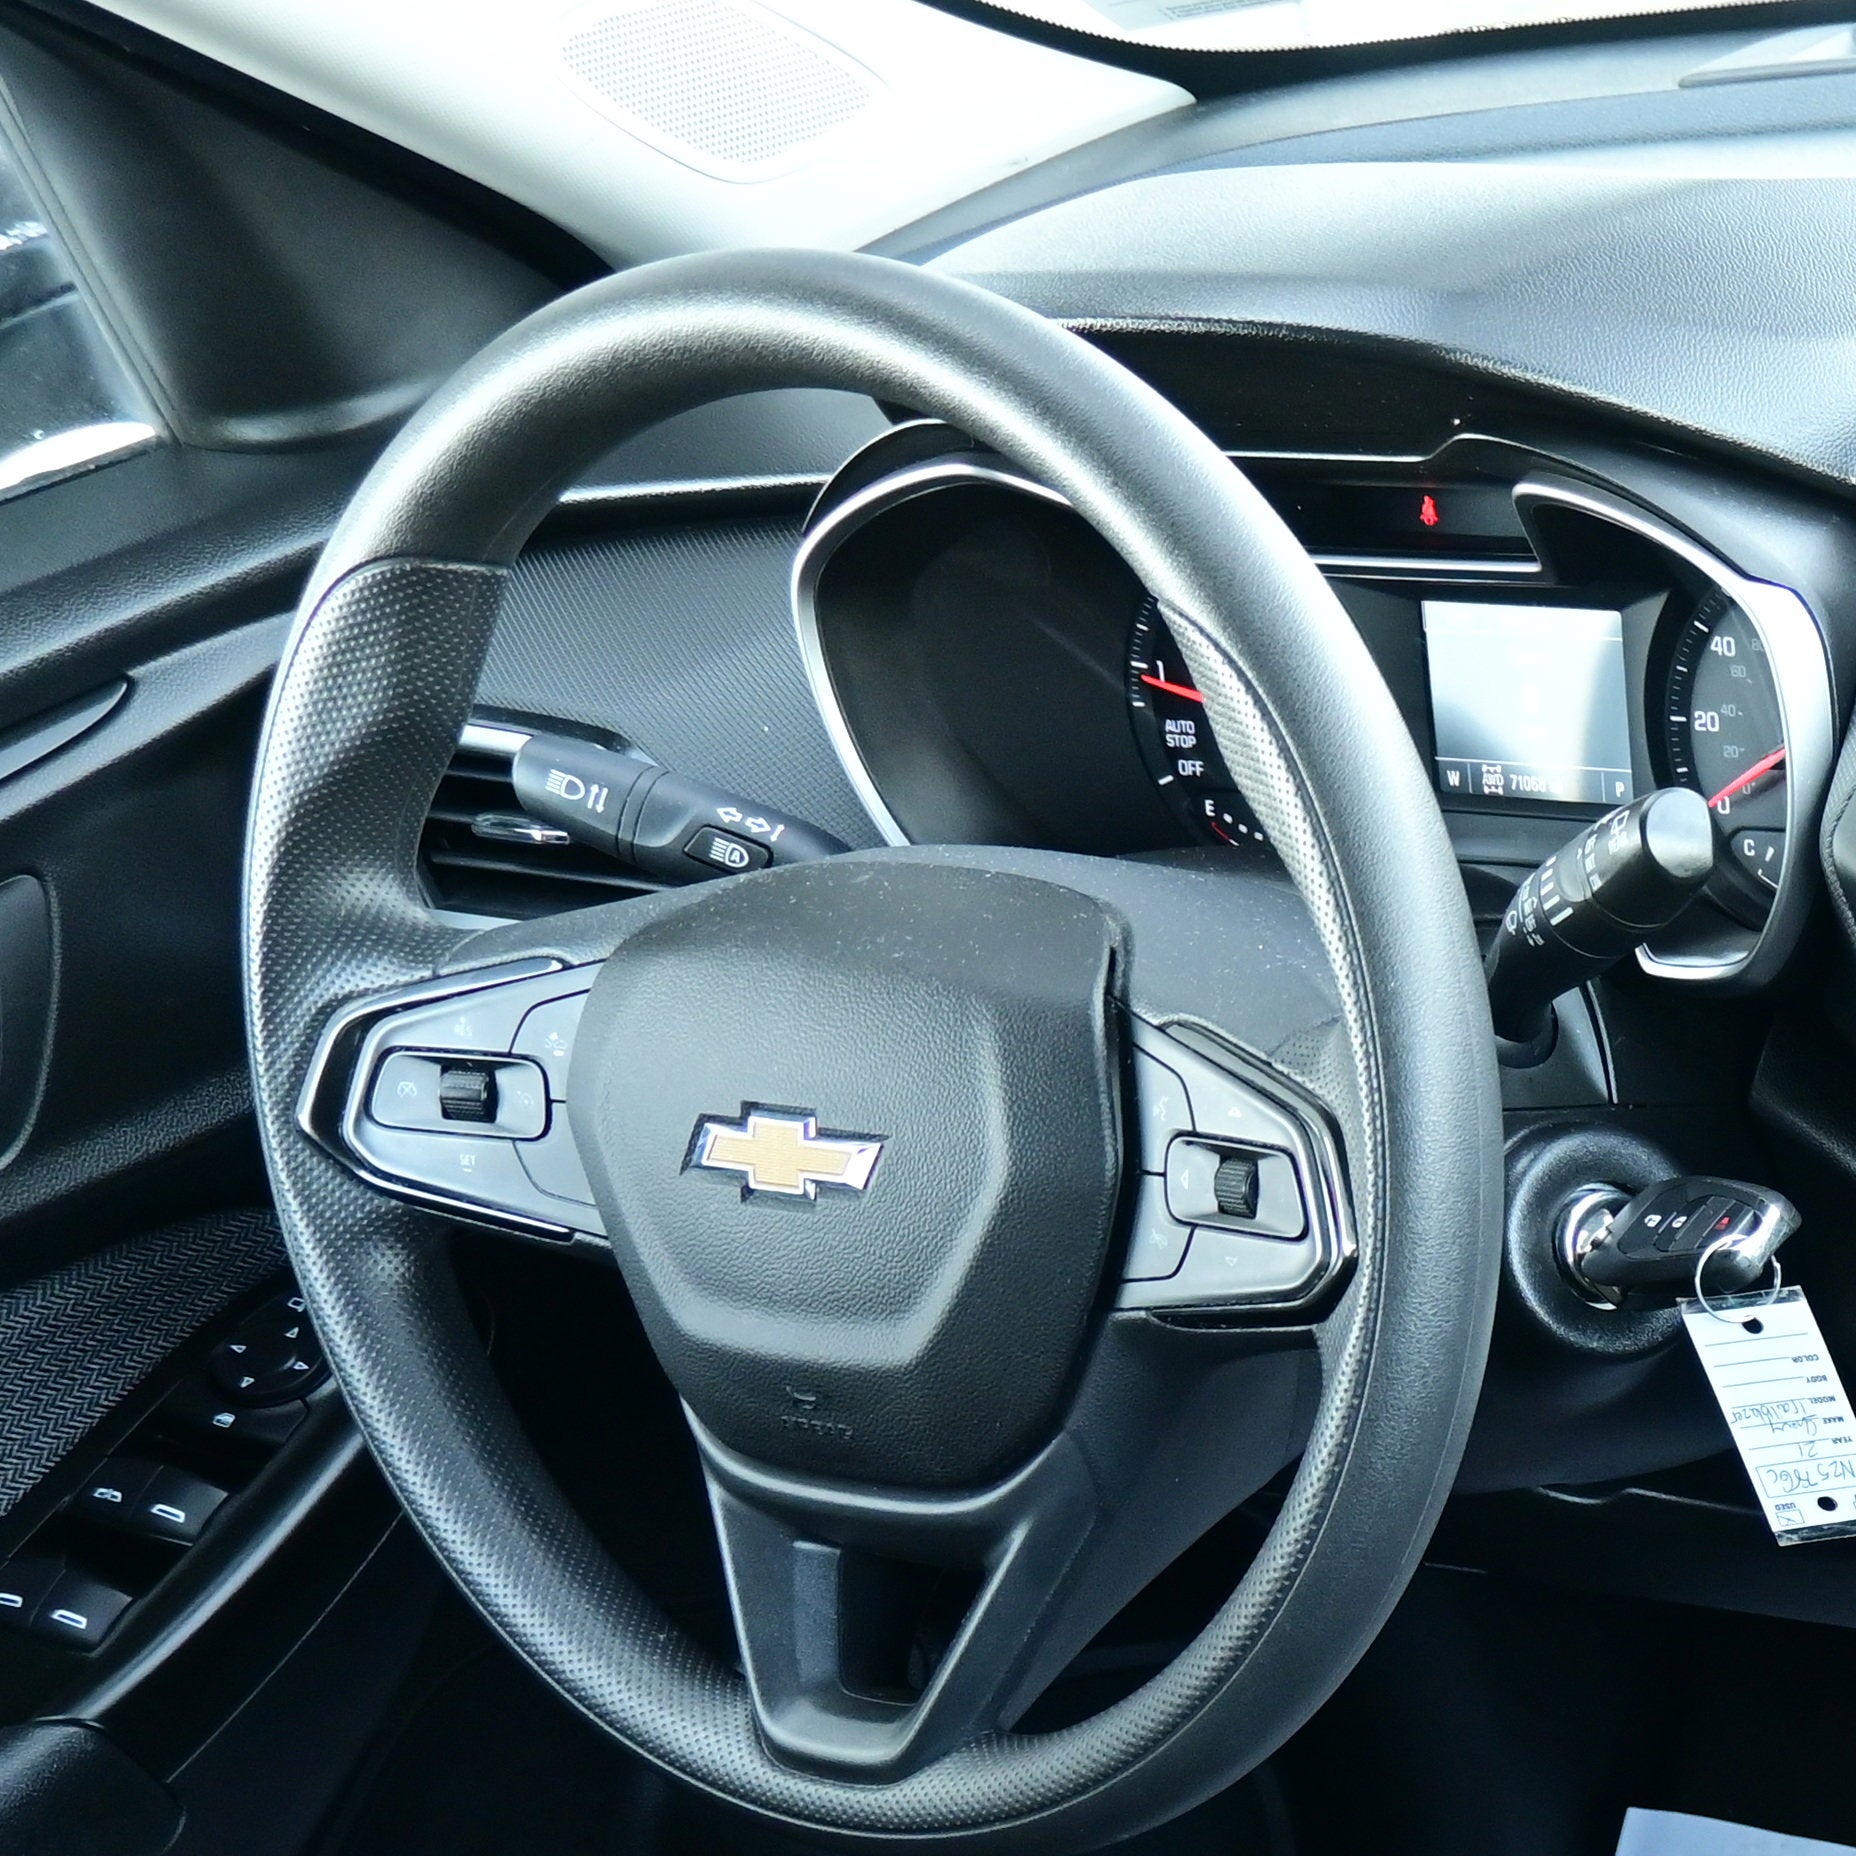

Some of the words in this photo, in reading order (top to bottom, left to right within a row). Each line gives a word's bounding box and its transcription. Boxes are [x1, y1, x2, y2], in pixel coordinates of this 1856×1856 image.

[1710, 636, 1736, 657] 40
[1720, 704, 1736, 717] 40
[1165, 719, 1196, 734] AUTO
[1694, 711, 1720, 732] 20
[1166, 733, 1197, 749] STOP
[1723, 745, 1739, 758] 20
[1178, 759, 1205, 777] OFF
[1447, 769, 1460, 787] W
[1615, 781, 1625, 798] P
[1204, 799, 1216, 817] E
[1743, 839, 1755, 857] C
[460, 1154, 475, 1166] SET
[1791, 1354, 1819, 1363] COLOR
[1806, 1374, 1828, 1383] BODY
[1810, 1395, 1836, 1404] MODEL
[1822, 1415, 1844, 1424] MAKE
[1831, 1437, 1853, 1445] YEAR
[1798, 1441, 1818, 1458] 21
[1775, 1502, 1796, 1511] USED
